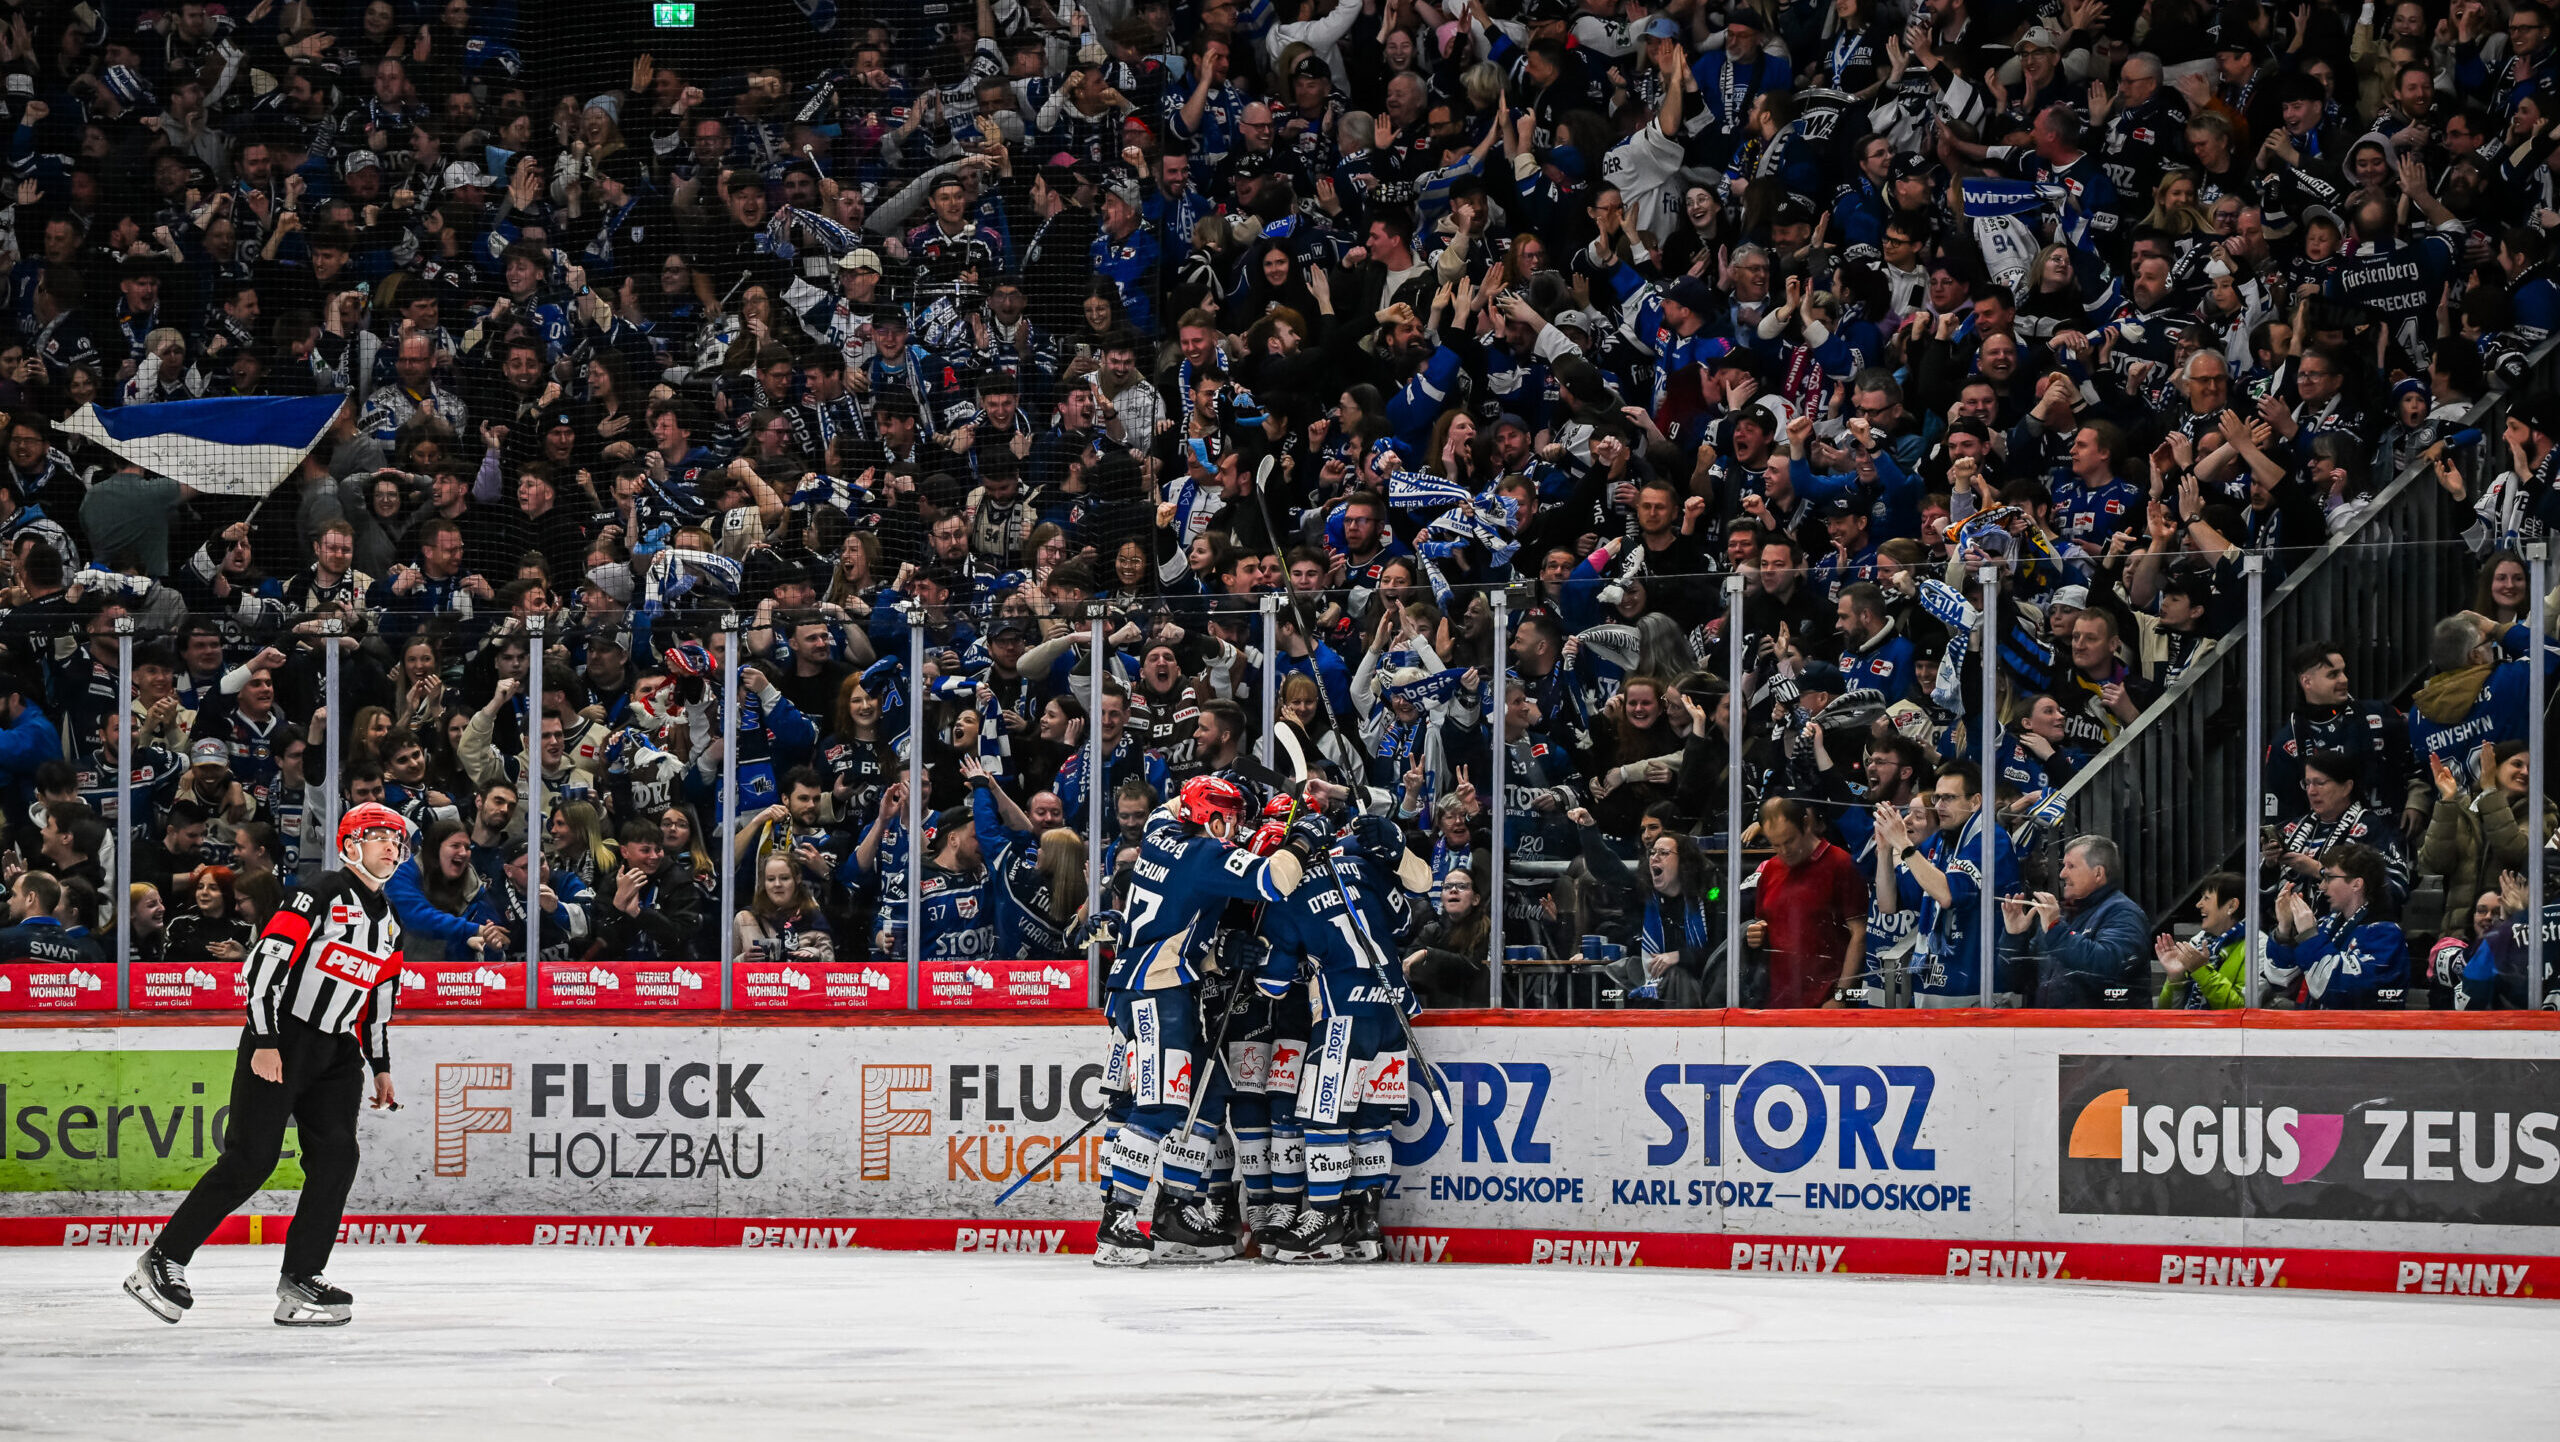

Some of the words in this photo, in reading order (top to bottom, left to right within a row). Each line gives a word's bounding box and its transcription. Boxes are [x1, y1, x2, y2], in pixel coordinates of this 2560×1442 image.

[1153, 723, 1174, 738] 93
[2425, 715, 2495, 754] SENYSHYN
[291, 891, 314, 913] 16
[928, 904, 947, 922] 37
[29, 941, 79, 961] SWAT
[935, 926, 996, 957] STOR
[145, 973, 183, 984] WERNER
[326, 952, 382, 985] PENN
[436, 972, 473, 983] WERNER
[553, 972, 587, 983] WERNER
[635, 972, 670, 983] WERNER
[747, 973, 780, 984] WERNER
[826, 973, 860, 984] WERNER
[932, 972, 964, 983] WERNER
[1009, 971, 1041, 982] WERNER
[30, 974, 67, 985] WERNER
[1009, 984, 1049, 995] WOHNBAU
[30, 986, 76, 998] WOHNBAU
[145, 985, 192, 997] WOHNBAU
[436, 985, 482, 996] WOHNBAU
[553, 985, 596, 996] WOHNBAU
[635, 985, 679, 996] WOHNBAU
[747, 986, 788, 997] WOHNBAU
[826, 986, 868, 997] WOHNBAU
[932, 985, 972, 996] WOHNBAU
[54, 999, 77, 1007] Glück!
[170, 999, 193, 1007] Glück!
[460, 998, 482, 1006] Glück!
[576, 998, 596, 1006] Glück!
[658, 998, 679, 1006] Glück!
[848, 999, 868, 1007] Glück!
[1029, 998, 1049, 1006] Glück!
[1138, 1007, 1151, 1044] STORZ
[1327, 1022, 1343, 1060] STORZ
[1107, 1043, 1125, 1082] STORZ
[1141, 1059, 1151, 1097] STORZ
[1379, 1081, 1405, 1091] ORCA
[531, 1063, 764, 1118] FLUCK
[949, 1064, 1103, 1121] FLUC
[1320, 1075, 1335, 1114] STORZ
[1389, 1061, 1551, 1166] ORZ
[1644, 1060, 1935, 1173] STORZ
[2121, 1105, 2300, 1177] ISGUS
[2364, 1111, 2560, 1184] ZEUS
[529, 1132, 763, 1179] HOLZBAU
[948, 1125, 1103, 1183] KÜCH
[1164, 1143, 1206, 1162] BURGER
[1320, 1157, 1352, 1171] BURGE
[1431, 1176, 1583, 1203] ENDOSKOPE
[1612, 1180, 1680, 1205] KARL
[63, 1223, 168, 1247] PENN
[335, 1223, 427, 1246] ENNY
[533, 1224, 654, 1247] PENNY
[741, 1226, 857, 1249] PENNY
[954, 1227, 1066, 1253] PENNY
[1385, 1234, 1450, 1263] NNY
[1531, 1239, 1640, 1266] PENNY
[1731, 1243, 1845, 1273] PENNY
[1946, 1248, 2067, 1280] PENNY
[2159, 1254, 2285, 1288] PENNY
[2396, 1261, 2530, 1296] PENNY
